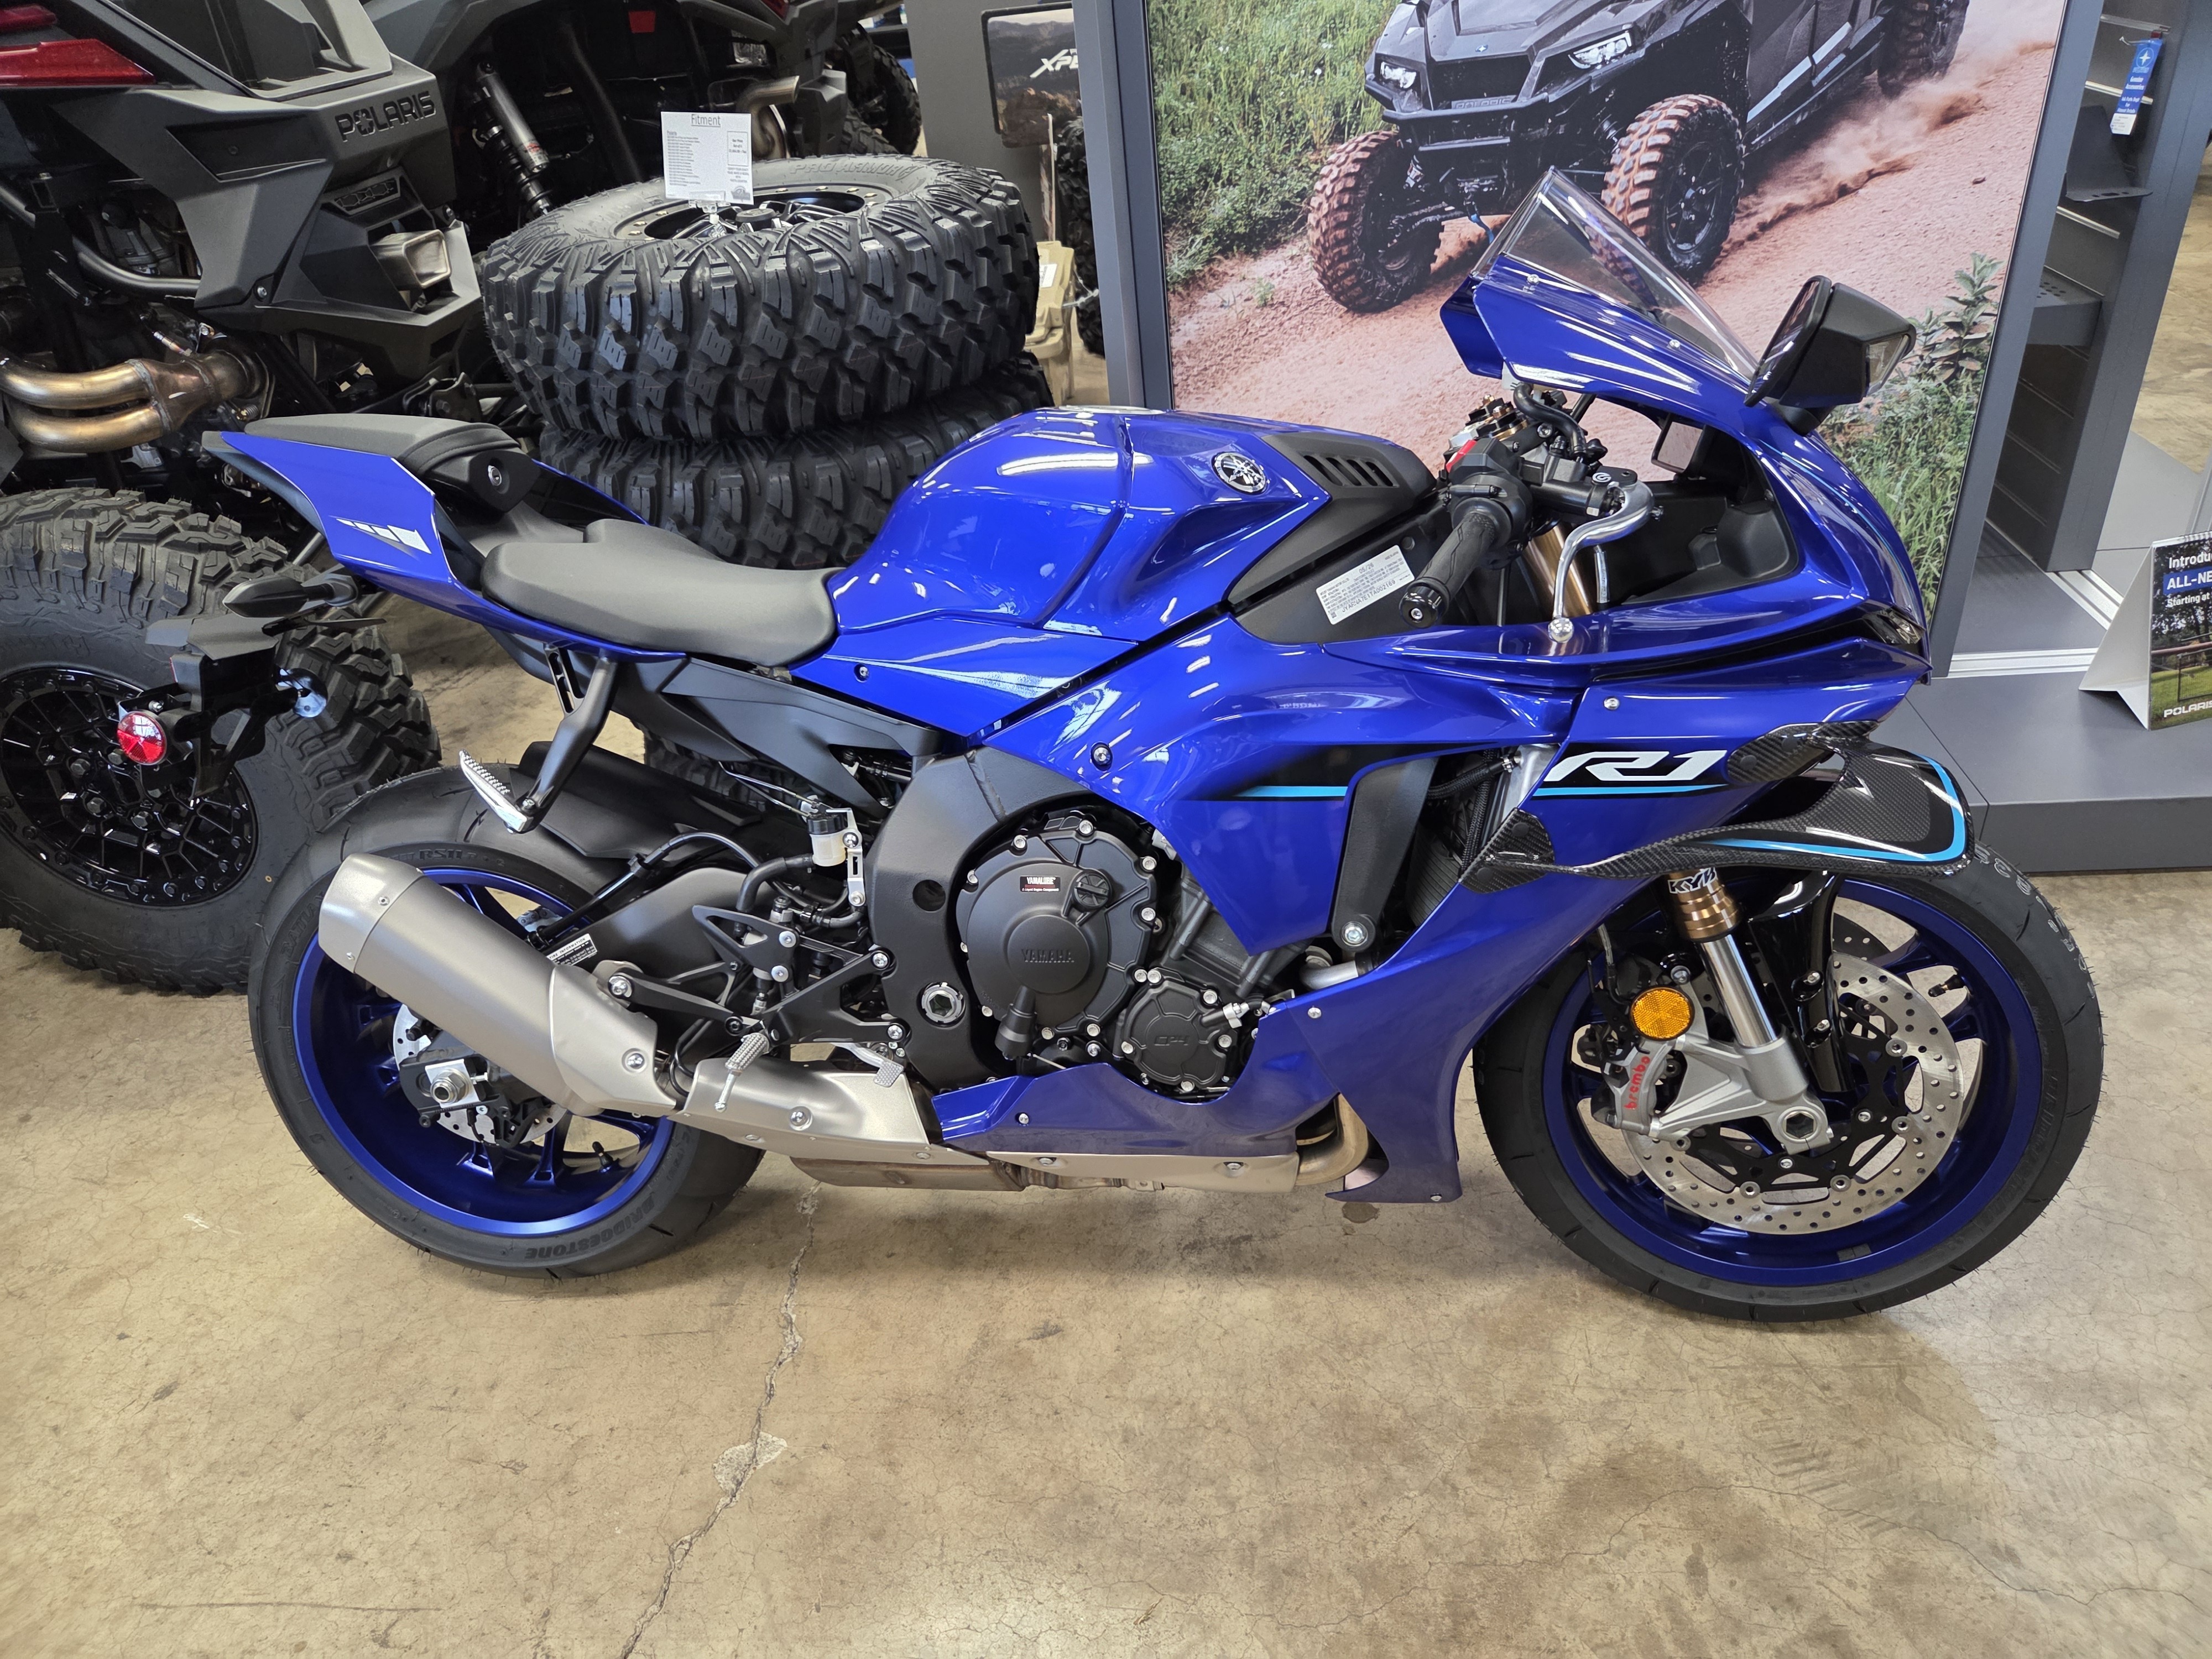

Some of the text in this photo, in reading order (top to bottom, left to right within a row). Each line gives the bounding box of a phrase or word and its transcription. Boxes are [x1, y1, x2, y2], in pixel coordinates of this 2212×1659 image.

[1030, 49, 1078, 78] XPE
[335, 91, 436, 143] POLARIS
[691, 114, 721, 126] Fitment
[790, 162, 900, 176] PRO ARMOR
[1359, 562, 1374, 573] 05/26
[2169, 551, 2212, 568] Introdu
[2166, 592, 2210, 608] Starting at
[2164, 700, 2212, 718] POLARIS
[1543, 750, 1728, 782] R1
[1667, 867, 1718, 894] KYB
[560, 938, 586, 954] INFORMATION
[1021, 948, 1074, 963] YAMAHA
[1154, 1035, 1190, 1046] CP4
[1624, 1056, 1651, 1110] brembo
[524, 1196, 656, 1260] BRIDGESTONE
